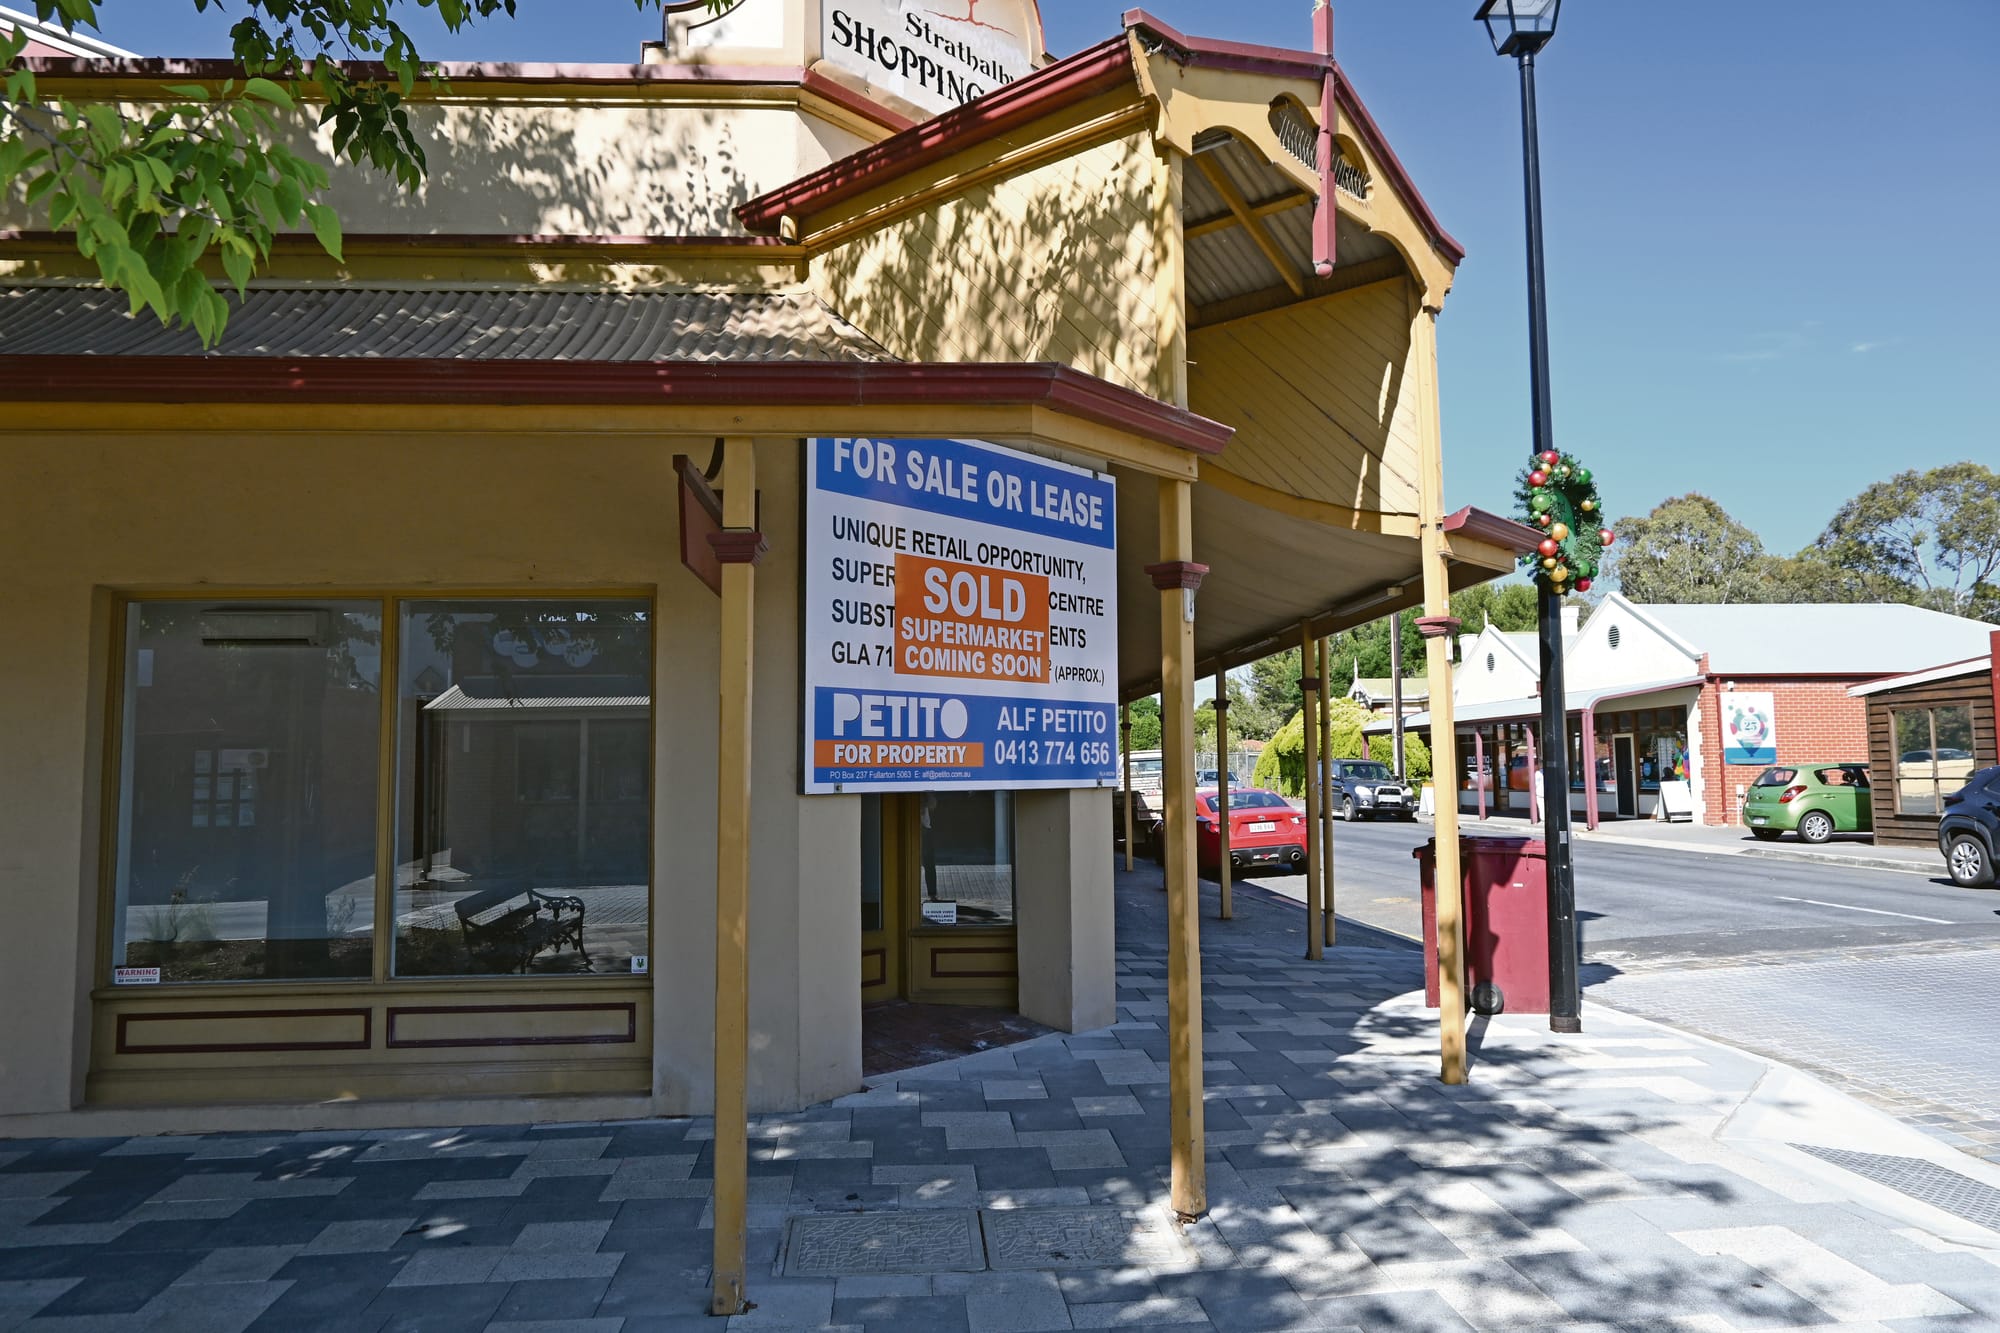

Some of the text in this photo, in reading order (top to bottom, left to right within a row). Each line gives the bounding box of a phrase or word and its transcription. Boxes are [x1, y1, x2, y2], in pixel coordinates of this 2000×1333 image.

[905, 12, 1014, 85] Strathalb
[834, 438, 1103, 530] FOR SALE OR LEASE
[832, 515, 1086, 585] UNIQUE RETAIL OPPORTUNITY,
[923, 566, 1026, 622] SOLD
[1049, 591, 1104, 617] CENTRE
[901, 616, 1045, 652] SUPERMARKET
[832, 641, 871, 666] GLA
[1055, 665, 1105, 687] (APPROX.)
[905, 645, 986, 674] COMING
[991, 654, 1041, 678] SOON
[833, 692, 968, 739] PETITO
[997, 706, 1107, 734] ALF PETITO
[834, 743, 967, 766] FOR PROPERTY
[994, 739, 1110, 766] 0413 774 656
[830, 771, 841, 779] PO
[842, 771, 854, 779] Box
[856, 771, 868, 779] 237
[117, 968, 158, 976] WARNING
